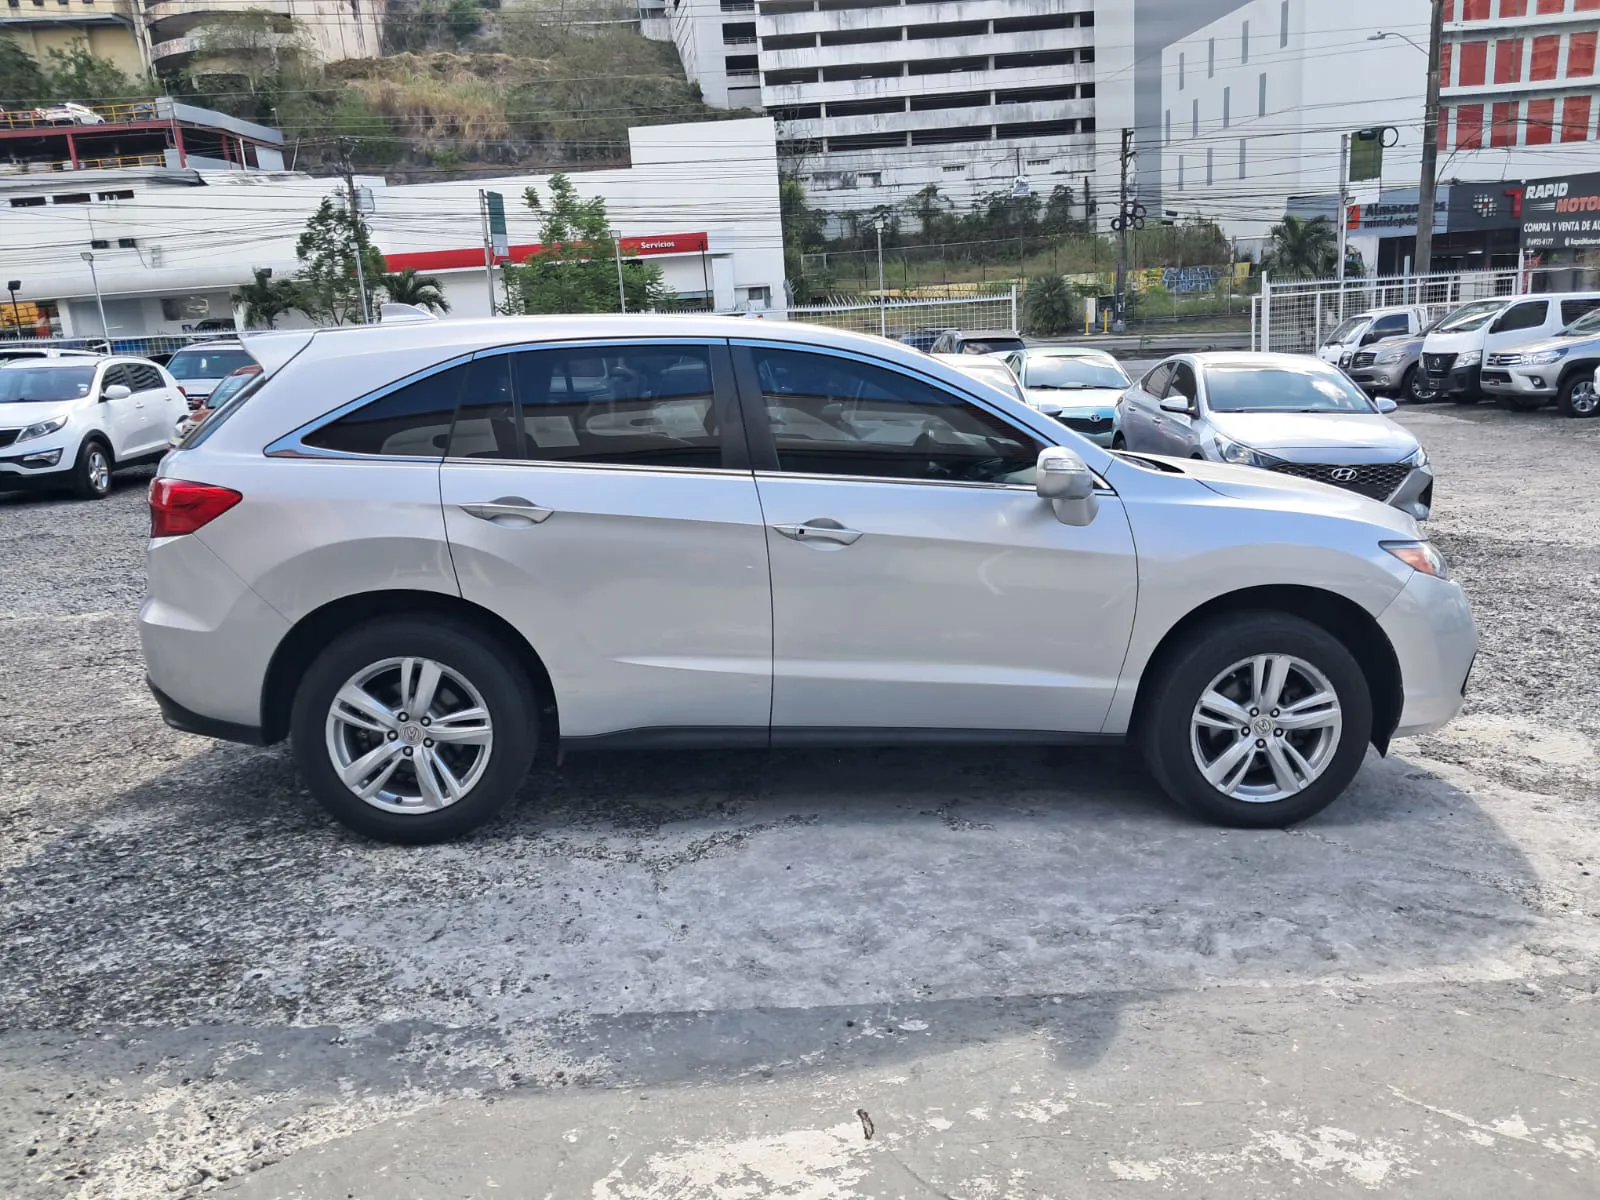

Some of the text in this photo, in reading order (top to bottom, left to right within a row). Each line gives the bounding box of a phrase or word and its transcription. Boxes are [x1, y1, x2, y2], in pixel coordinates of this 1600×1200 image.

[1525, 183, 1568, 199] RAPID
[1524, 222, 1551, 233] COMPRA
[1552, 222, 1557, 232] Y
[1558, 220, 1580, 232] VENTA
[1581, 219, 1591, 231] DE
[640, 241, 675, 249] Servicios
